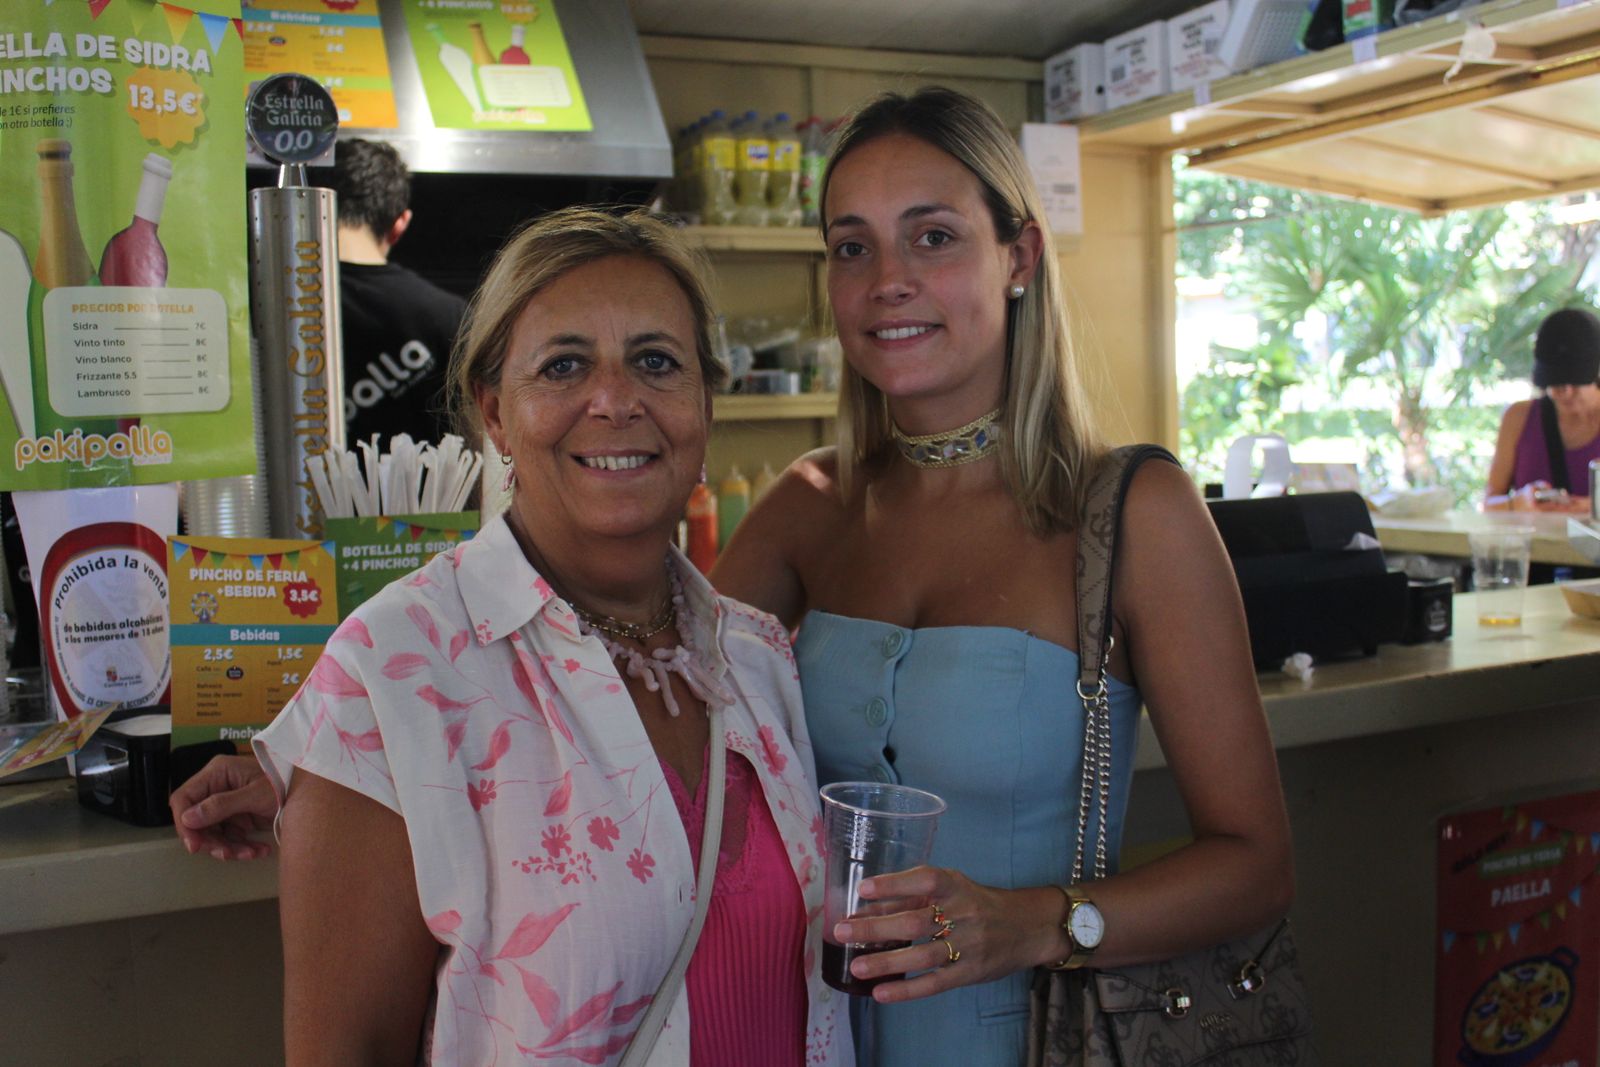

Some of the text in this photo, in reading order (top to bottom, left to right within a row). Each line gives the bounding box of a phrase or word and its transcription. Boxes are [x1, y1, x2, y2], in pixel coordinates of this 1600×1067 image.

[76, 33, 118, 59] DE
[123, 38, 211, 73] SIDRA
[129, 84, 197, 114] 13,5€
[265, 93, 324, 111] Estrella
[9, 105, 22, 116] 1€
[33, 104, 76, 116] prefieres
[31, 116, 64, 128] botella
[267, 109, 323, 127] Galicia
[72, 304, 125, 313] PRECIOS
[284, 241, 326, 377] Galicia
[73, 322, 98, 331] Sidra
[74, 339, 101, 347] Vinto
[103, 339, 126, 347] tinto
[75, 356, 98, 364] Vino
[101, 355, 132, 364] blanco
[76, 372, 122, 381] Frizzante
[124, 371, 137, 380] 5.5
[77, 388, 131, 398] Lambrusco
[15, 425, 173, 471] pakipalla
[342, 544, 402, 558] BOTELLA
[405, 543, 421, 554] DE
[351, 561, 359, 571] 4
[362, 557, 419, 570] PINCHOS
[55, 554, 167, 610] Prohibida la venta
[190, 568, 308, 583] PINCHO DE FERIA
[64, 623, 73, 633] de
[74, 621, 117, 633] bebidas
[70, 635, 81, 643] los
[84, 633, 125, 643] menores
[128, 630, 139, 639] de
[230, 629, 280, 641] Bebidas
[204, 648, 234, 661] 2,5€
[1490, 878, 1552, 908] PAELLA
